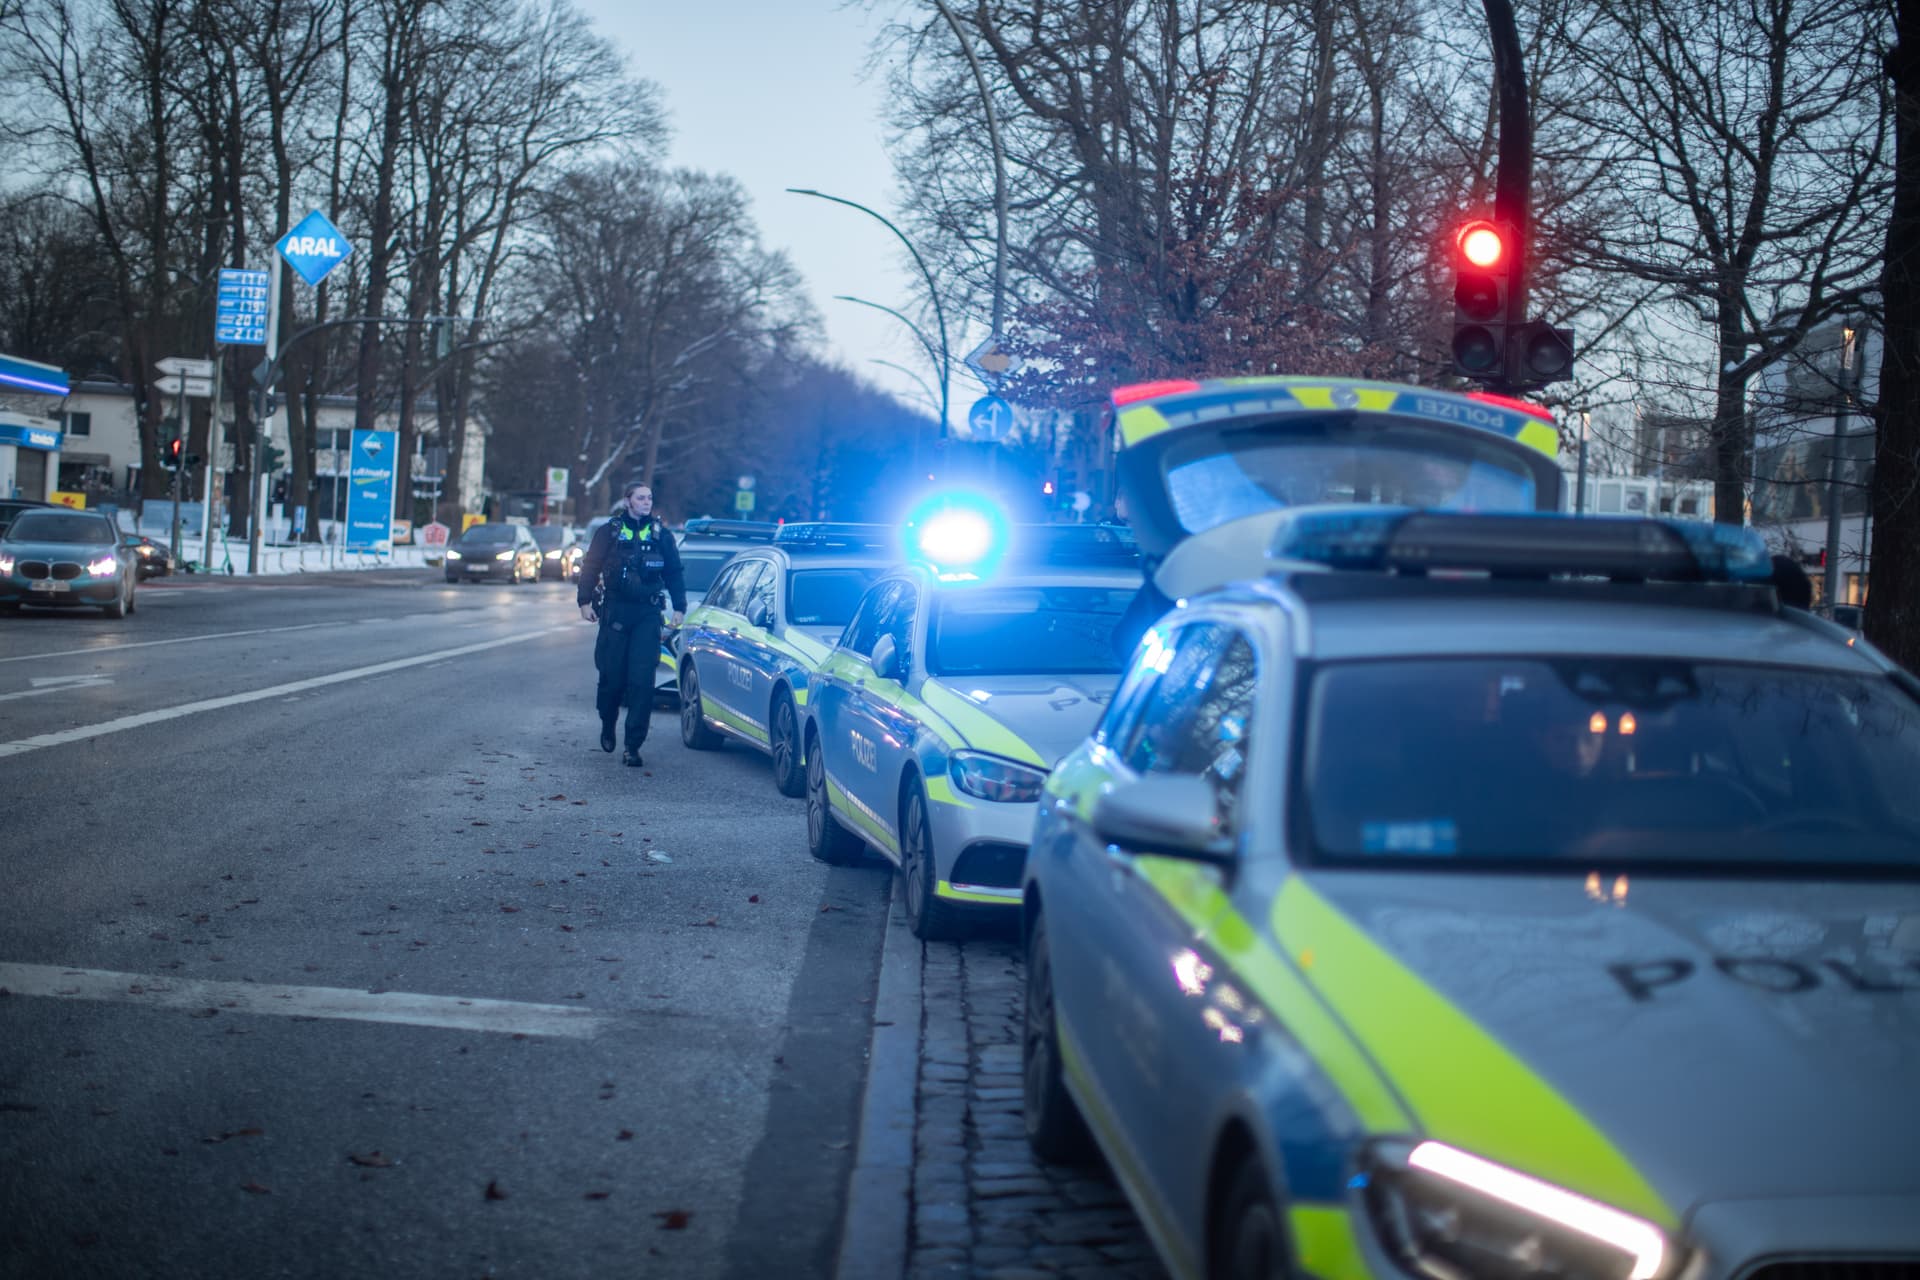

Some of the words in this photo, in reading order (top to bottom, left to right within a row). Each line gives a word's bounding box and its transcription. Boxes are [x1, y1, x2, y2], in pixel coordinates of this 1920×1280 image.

[285, 236, 341, 257] ARAL
[1416, 398, 1504, 428] POLIZEI
[728, 661, 753, 693] POLIZEI
[851, 729, 877, 773] POLIZEI
[1606, 956, 1920, 1003] POL
